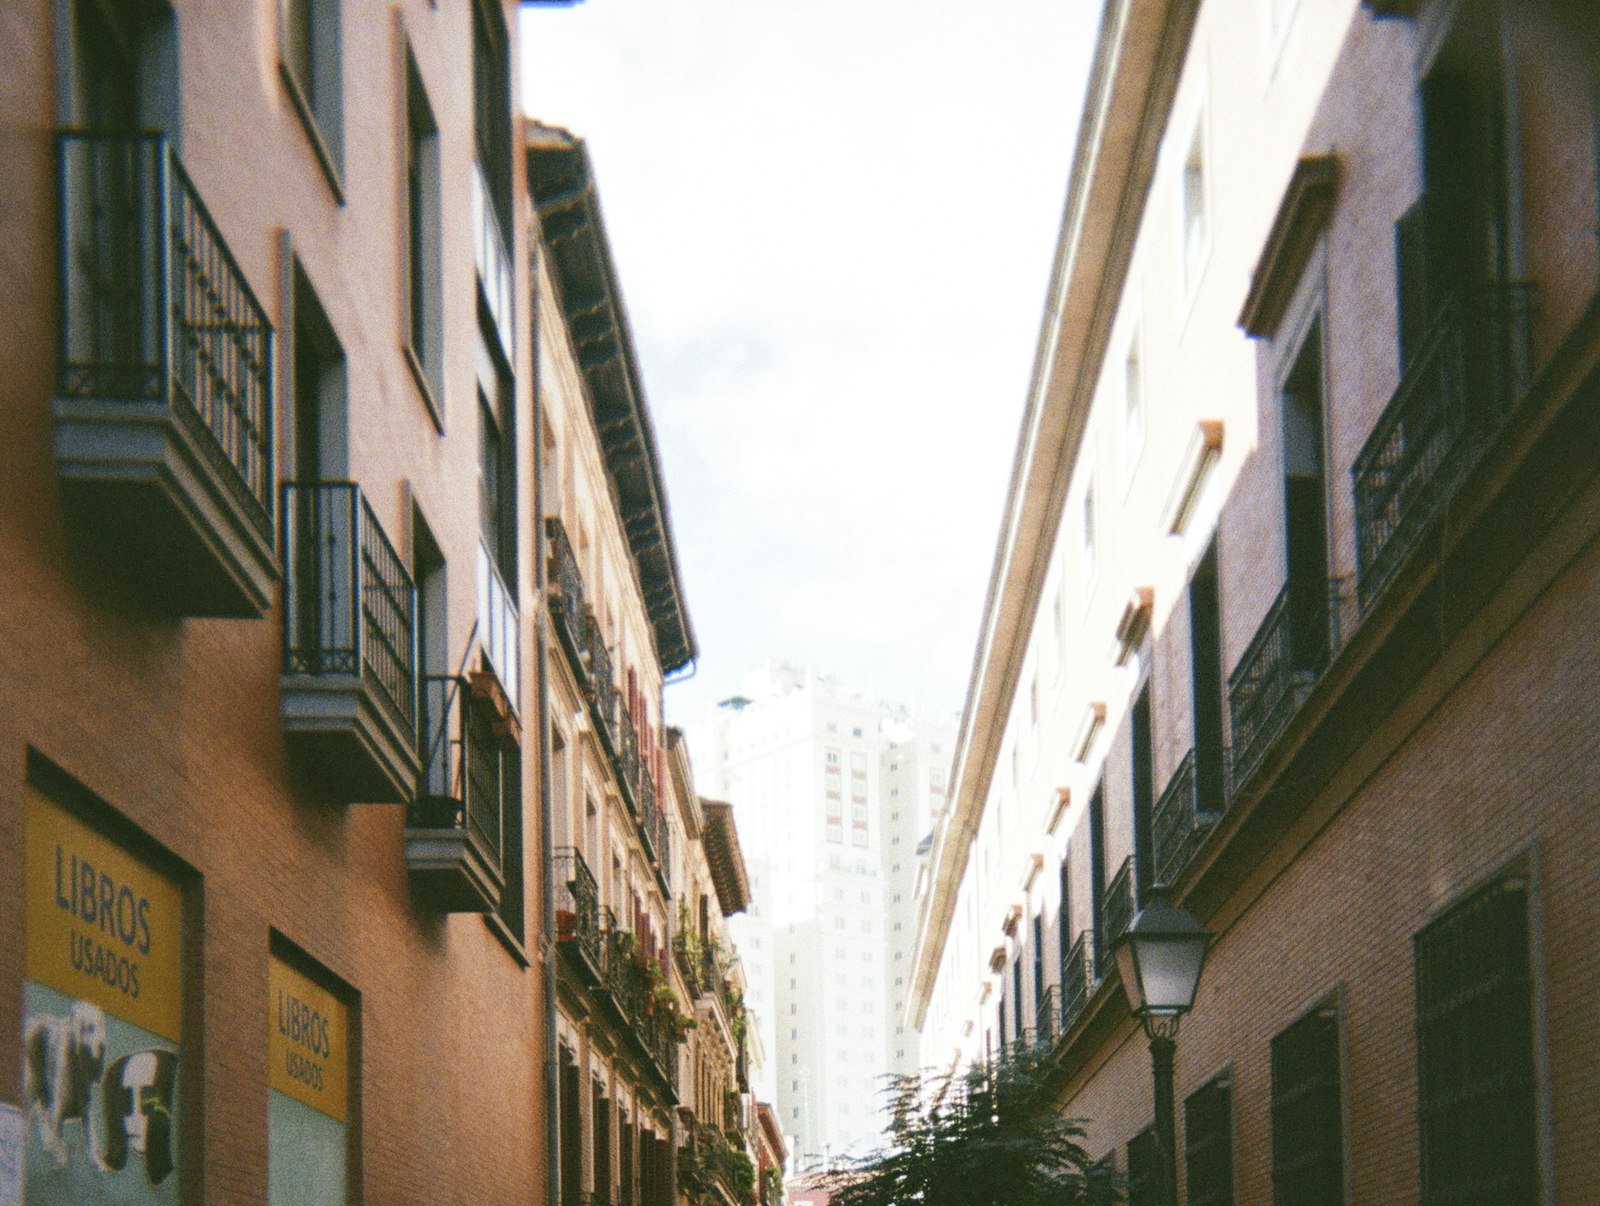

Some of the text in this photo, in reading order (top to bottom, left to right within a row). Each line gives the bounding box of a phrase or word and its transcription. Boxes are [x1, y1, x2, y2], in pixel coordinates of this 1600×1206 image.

[55, 845, 151, 955] LIBROS
[70, 929, 139, 998] USADOS
[277, 988, 329, 1060] LIBROS
[286, 1047, 323, 1092] USADOS
